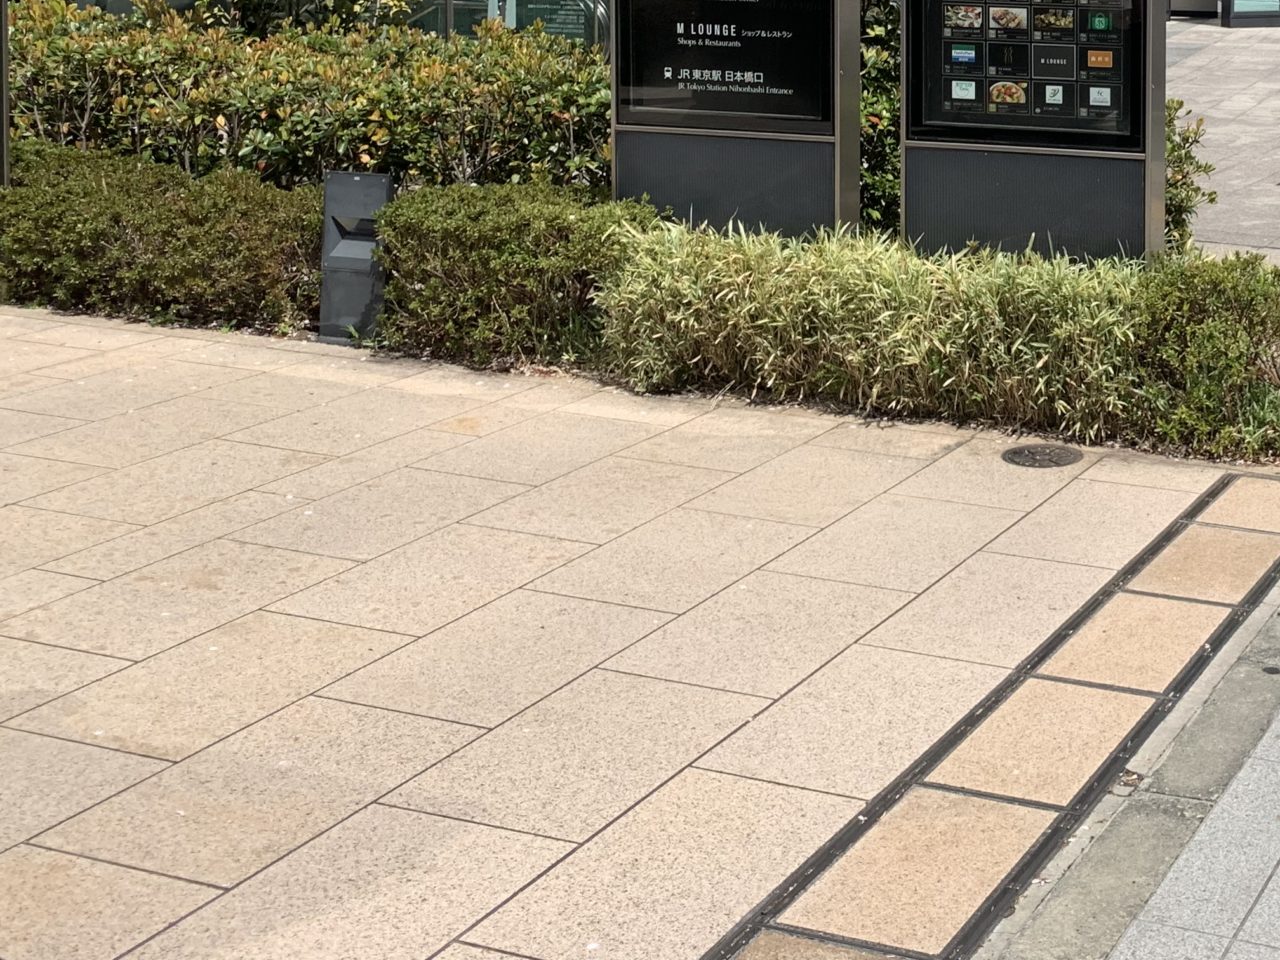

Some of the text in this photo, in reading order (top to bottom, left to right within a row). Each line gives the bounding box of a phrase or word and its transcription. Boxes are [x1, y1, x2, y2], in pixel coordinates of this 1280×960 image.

[676, 22, 685, 34] M
[690, 23, 737, 37] LOUNGE
[677, 37, 741, 47] Shops & Restaurants
[725, 70, 764, 83] 日本橋口
[686, 82, 706, 92] Tokyo
[706, 83, 728, 92] Station
[728, 84, 765, 94] Nihonbashi
[766, 86, 794, 95] Entrance
